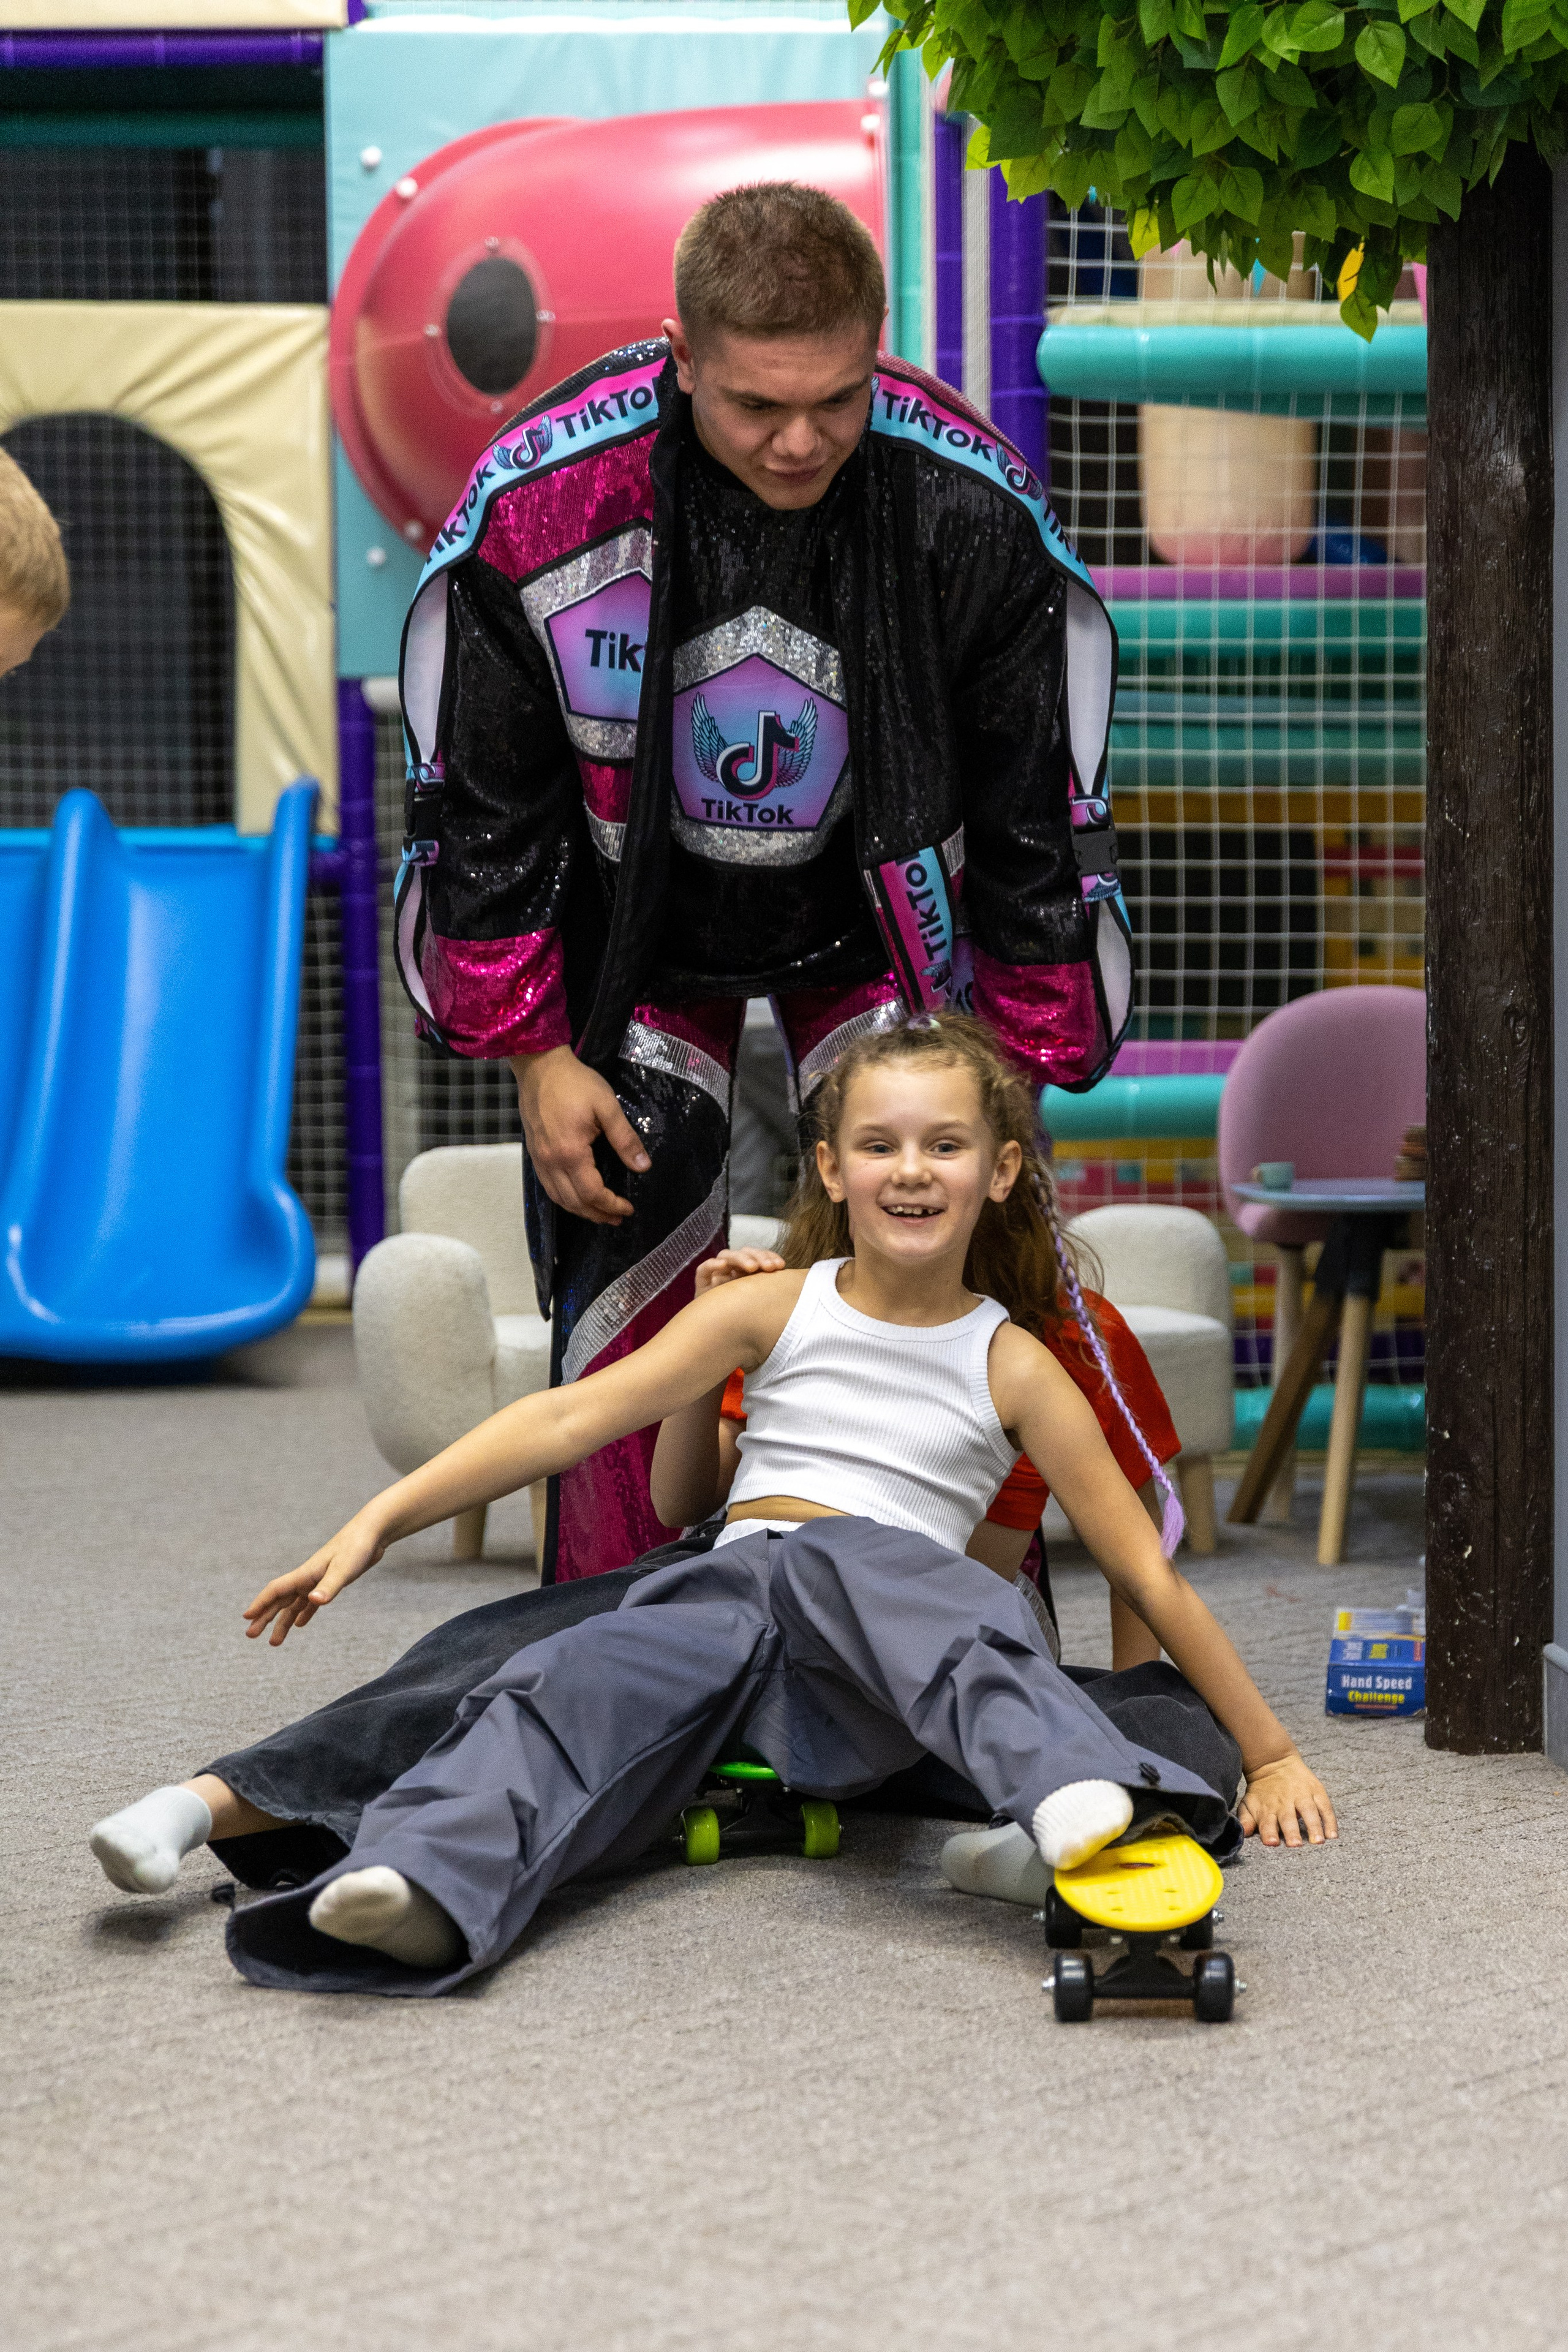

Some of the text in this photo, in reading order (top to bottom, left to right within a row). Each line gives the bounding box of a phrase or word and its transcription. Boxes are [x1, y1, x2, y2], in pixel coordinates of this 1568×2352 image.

[556, 377, 660, 439] TikTo
[882, 389, 993, 462] TikTok
[426, 461, 496, 565] ikTok
[585, 628, 646, 673] Tik
[701, 797, 794, 824] TikTok
[895, 852, 948, 961] TikTo
[1341, 1675, 1412, 1691] Hand Speed
[1348, 1691, 1405, 1704] Challenge
